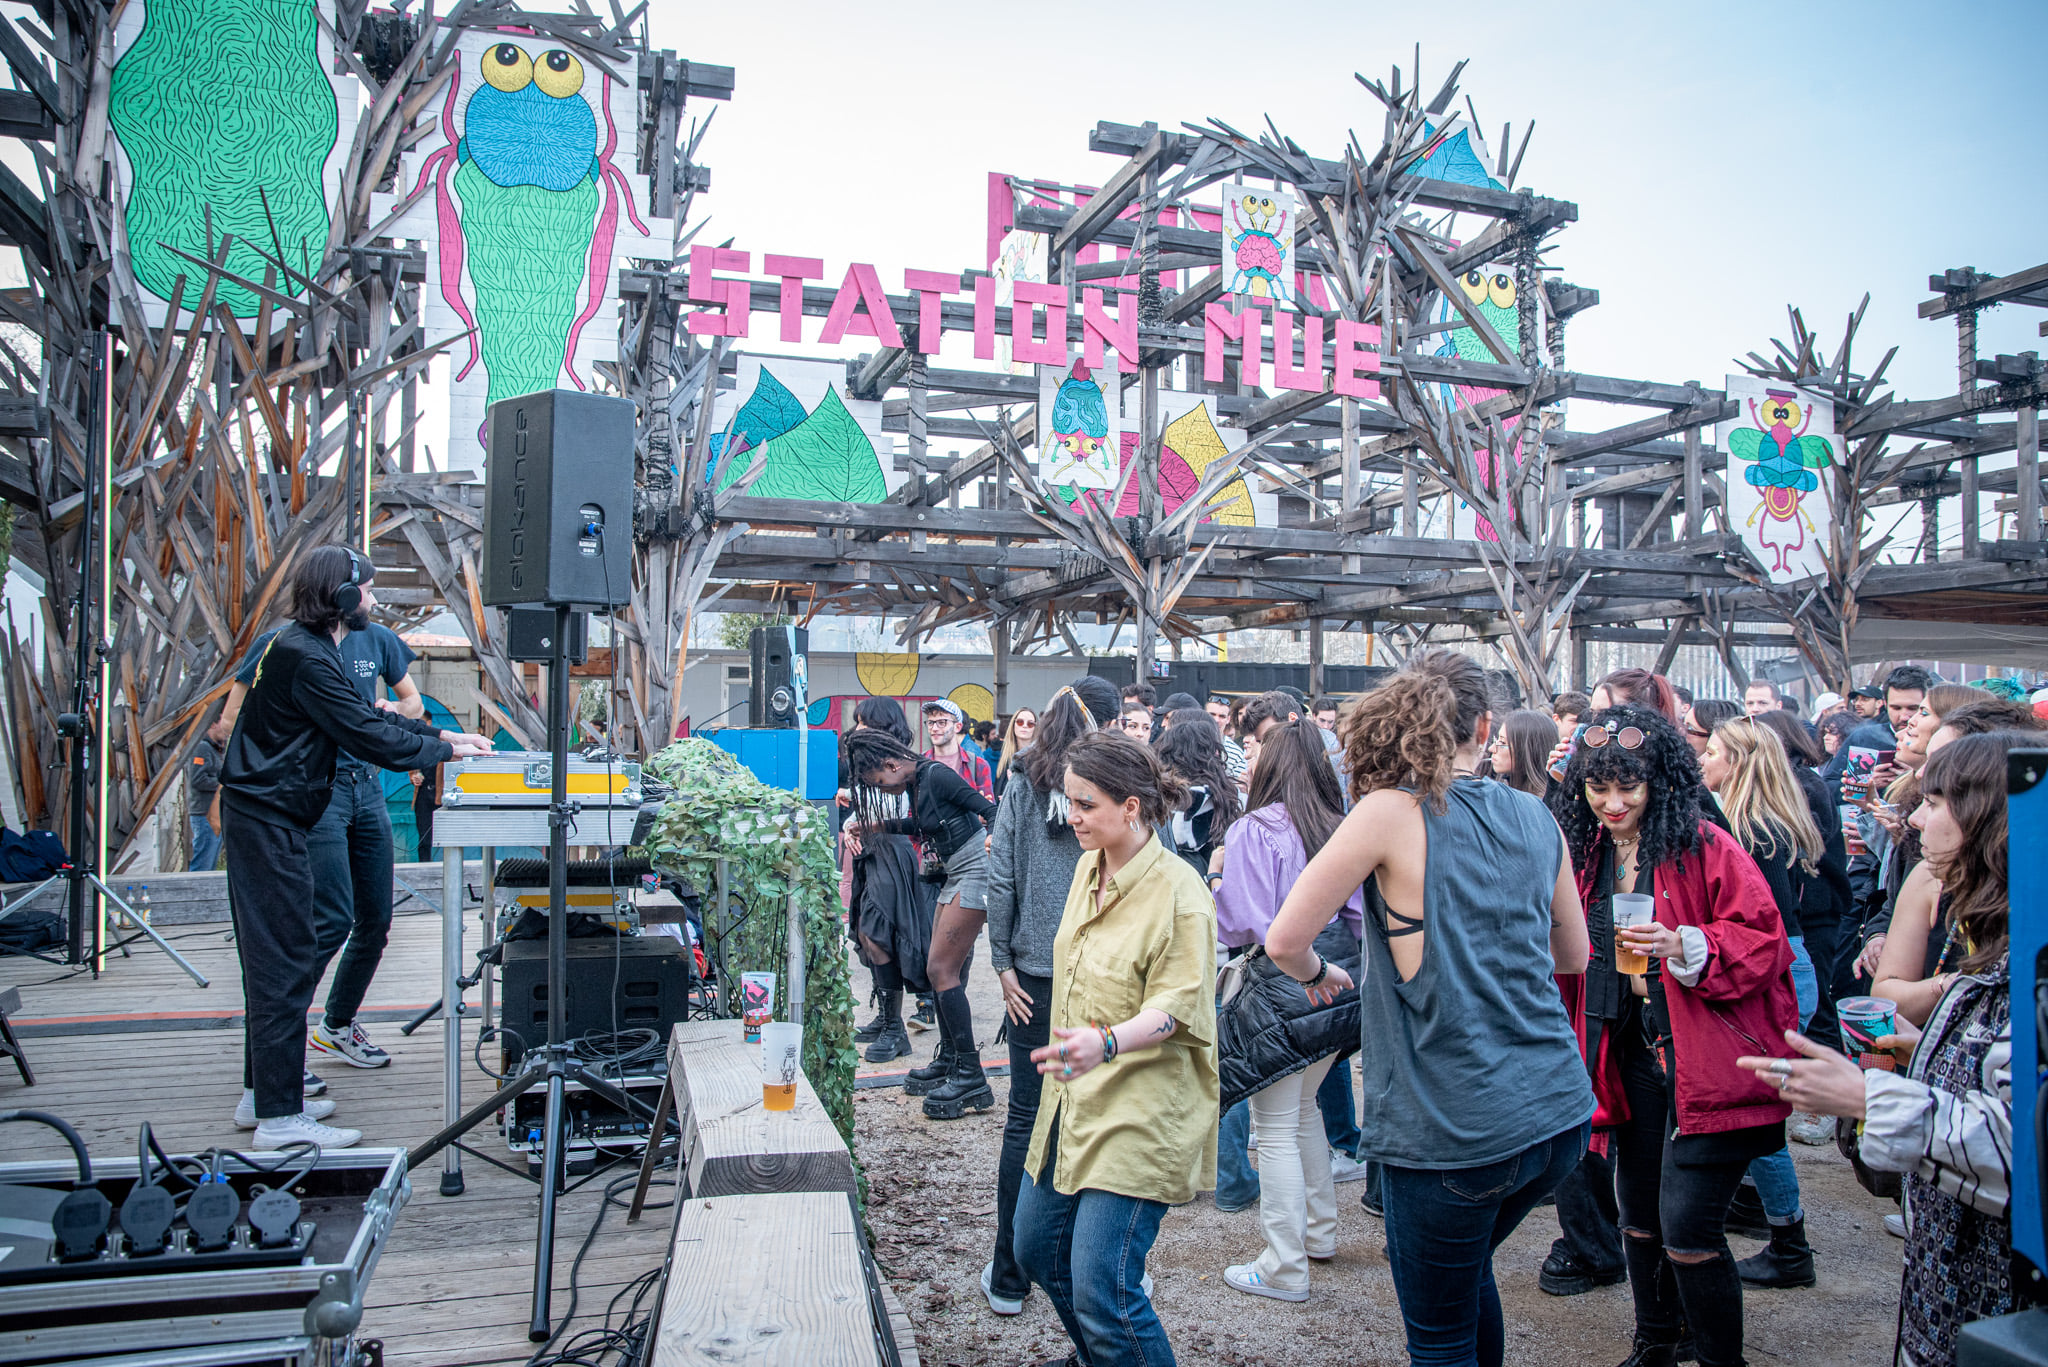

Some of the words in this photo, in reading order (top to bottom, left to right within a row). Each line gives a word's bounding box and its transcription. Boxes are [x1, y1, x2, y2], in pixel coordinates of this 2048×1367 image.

[688, 244, 1139, 373] STATION
[1204, 302, 1382, 399] MUE
[509, 408, 528, 591] elokance
